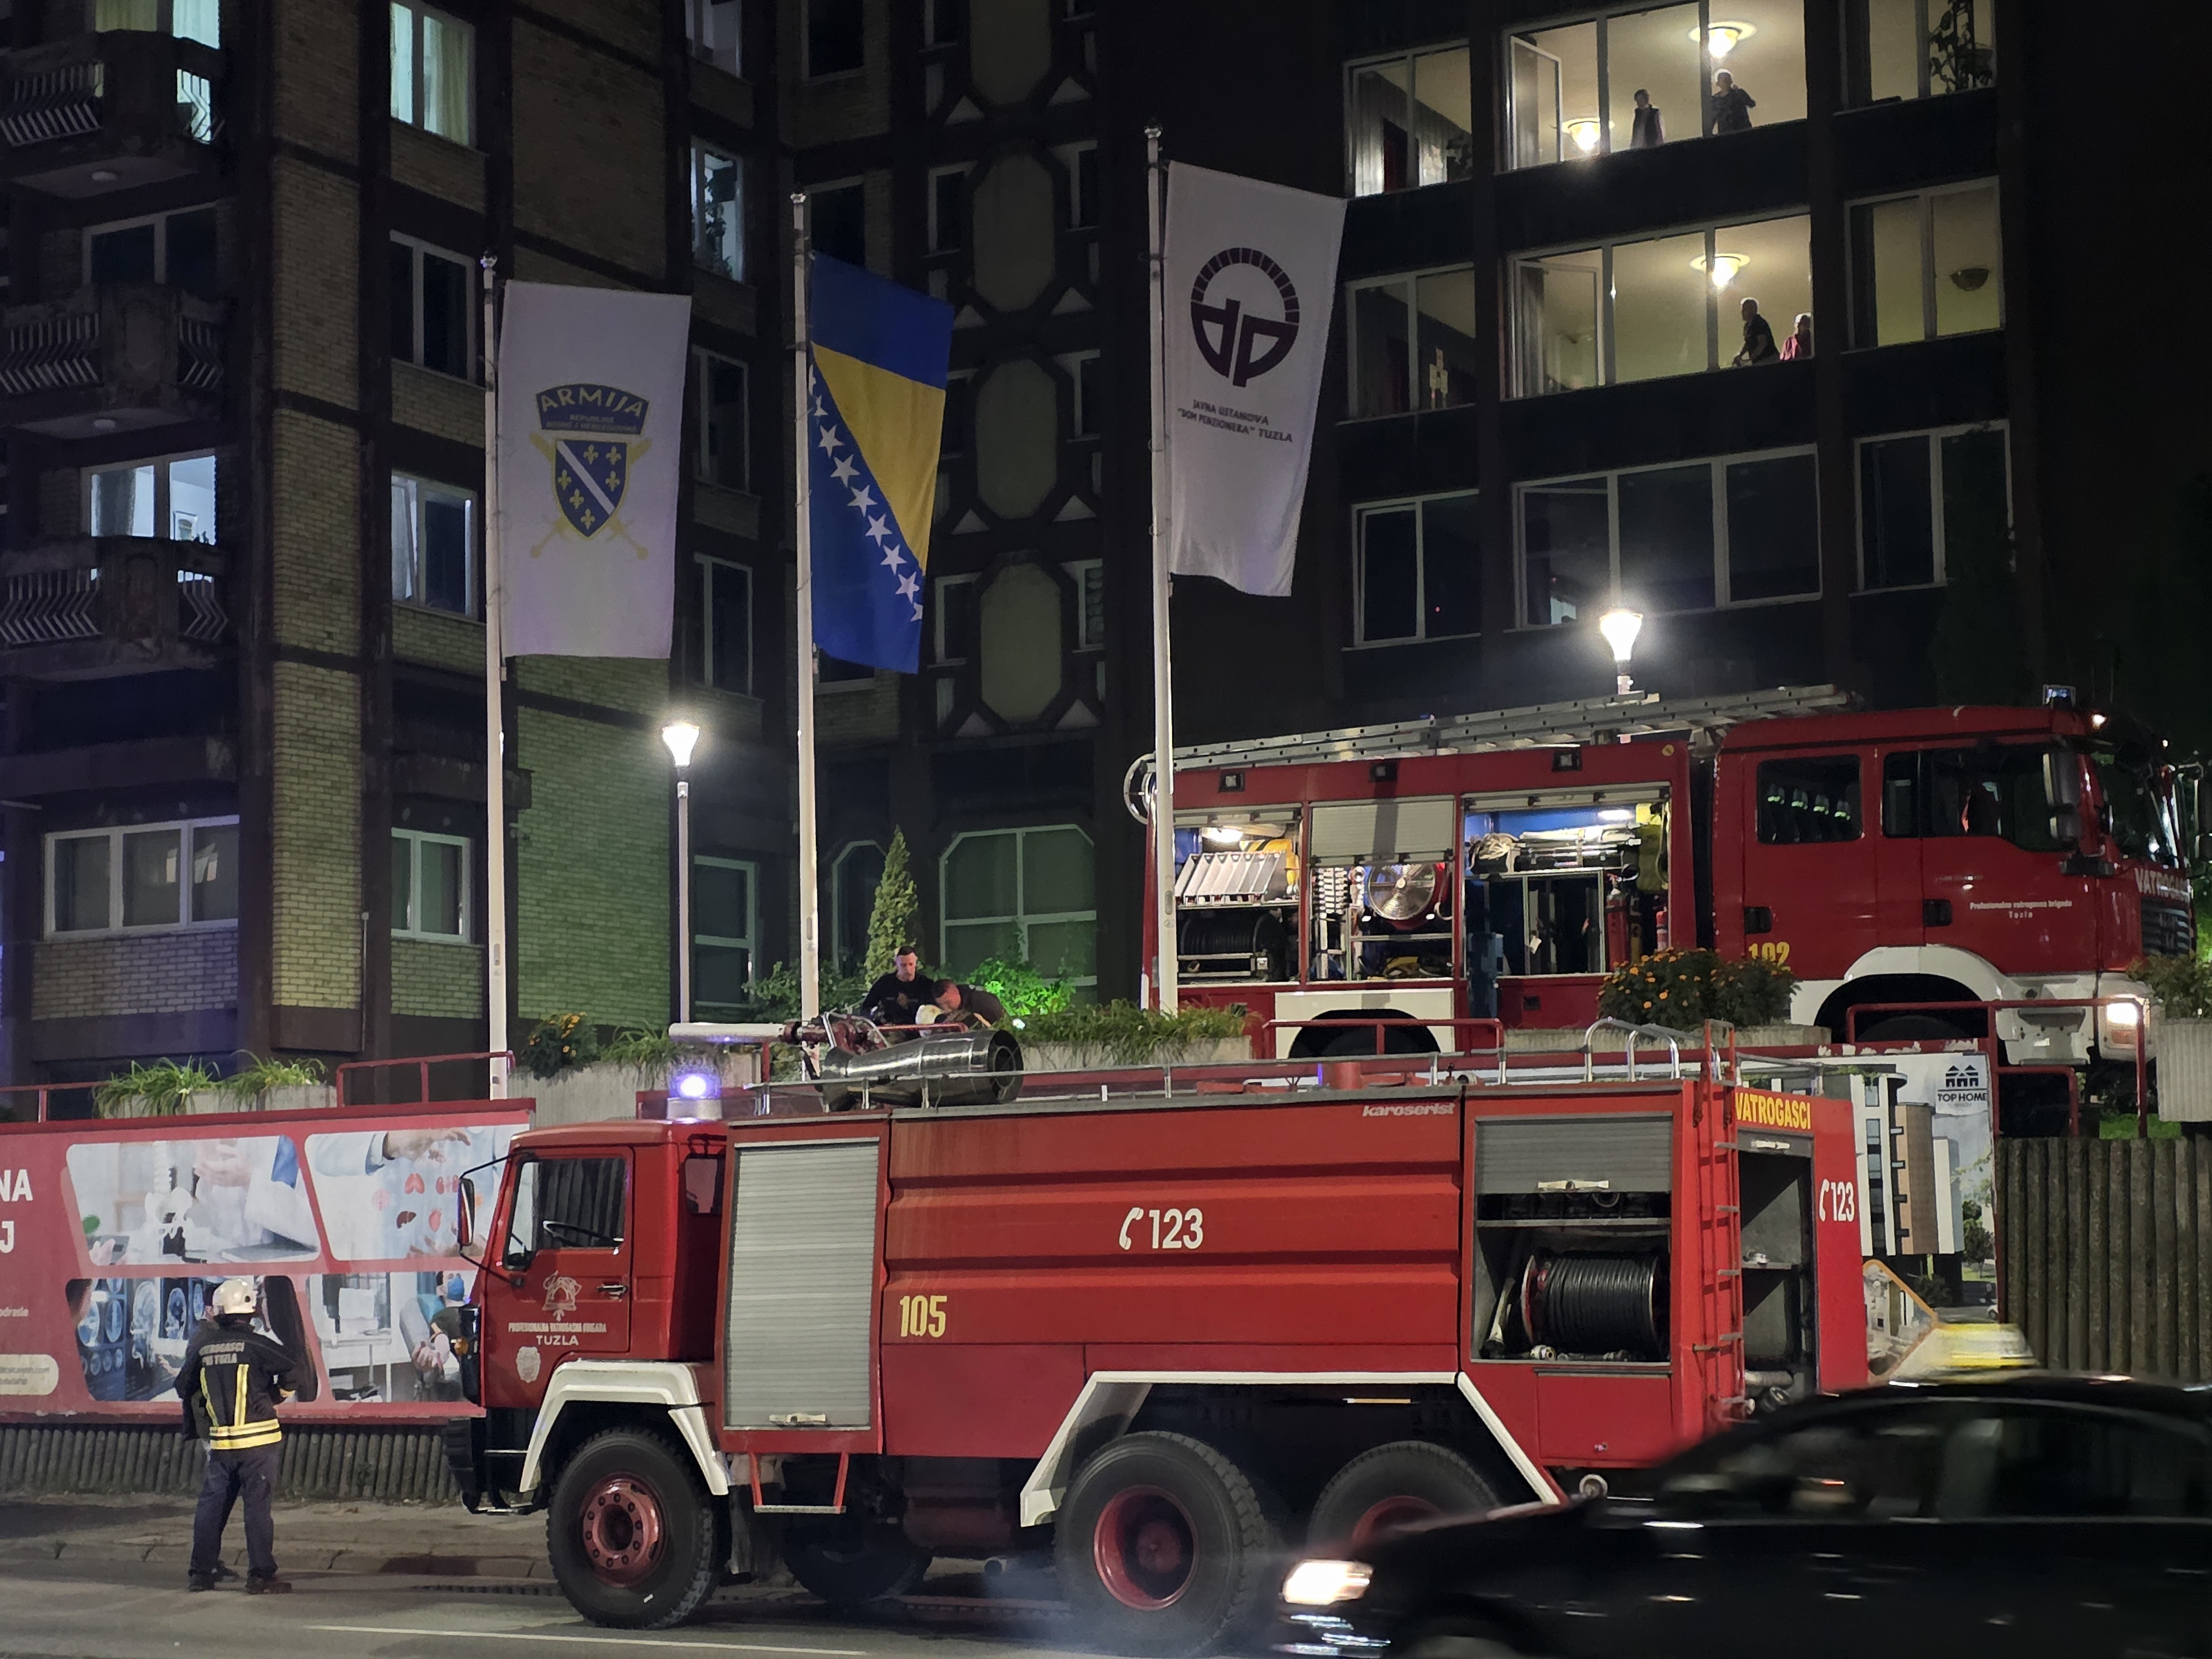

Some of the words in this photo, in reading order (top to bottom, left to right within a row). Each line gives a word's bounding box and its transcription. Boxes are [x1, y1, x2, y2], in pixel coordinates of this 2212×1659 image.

[541, 388, 643, 417] ARMIJA
[1258, 428, 1293, 442] TUZLA
[1749, 942, 1791, 972] 102
[1735, 1092, 1811, 1129] VATROGASCI
[1938, 1093, 1957, 1102] TOP
[1831, 1182, 1854, 1222] 123
[1149, 1208, 1203, 1249] 123
[900, 1295, 947, 1338] 105
[536, 1335, 578, 1345] TUZLA
